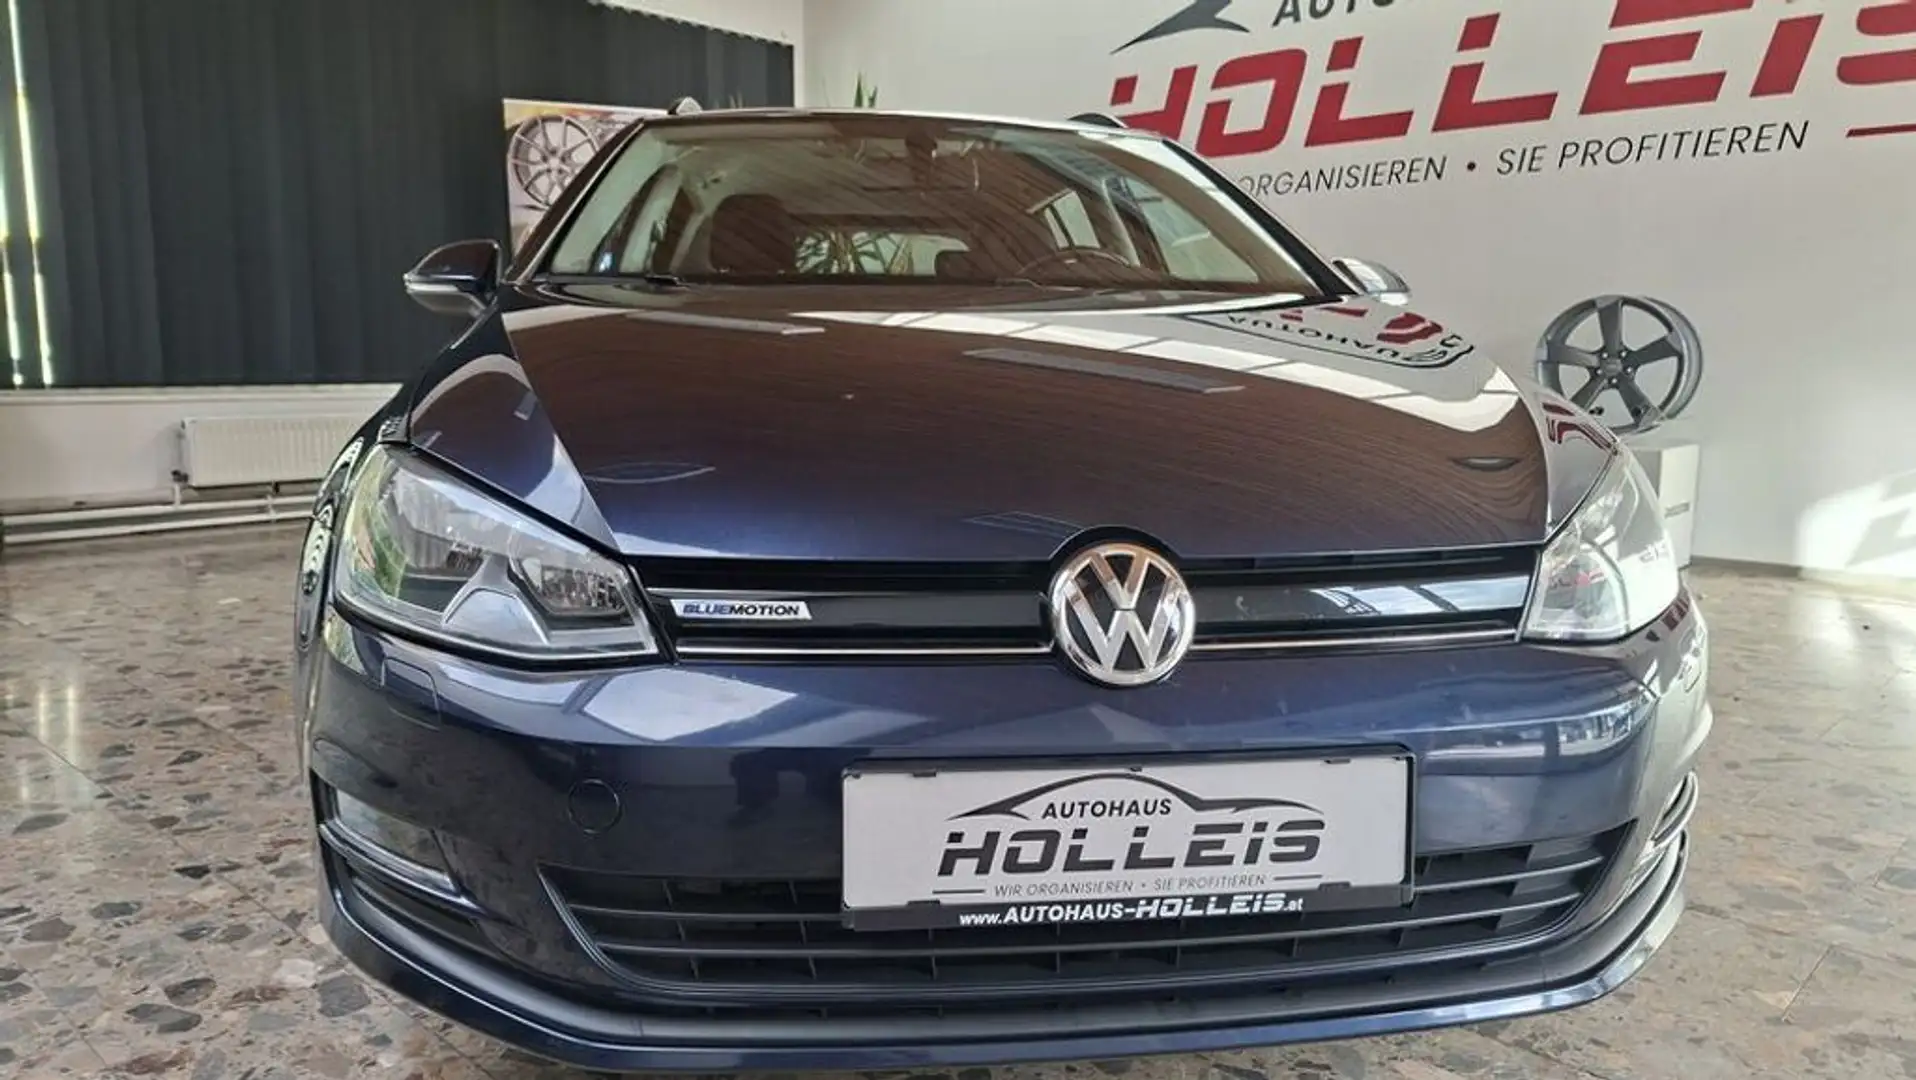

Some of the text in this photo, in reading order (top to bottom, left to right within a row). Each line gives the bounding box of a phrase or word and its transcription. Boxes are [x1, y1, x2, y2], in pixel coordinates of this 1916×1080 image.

[1497, 144, 1548, 176] SIE
[1558, 120, 1810, 170] PROFITIEREN
[682, 602, 800, 617] BLUEMOTION
[1058, 548, 1186, 678] VW
[1041, 798, 1173, 820] AUTOHAUS
[936, 819, 1326, 877] HOLLEIS
[994, 873, 1268, 898] WIR ORGANISIEREN SIE PROFITIEREN
[958, 892, 1304, 926] www.AUTOHAUS-HOLLEIS.at
